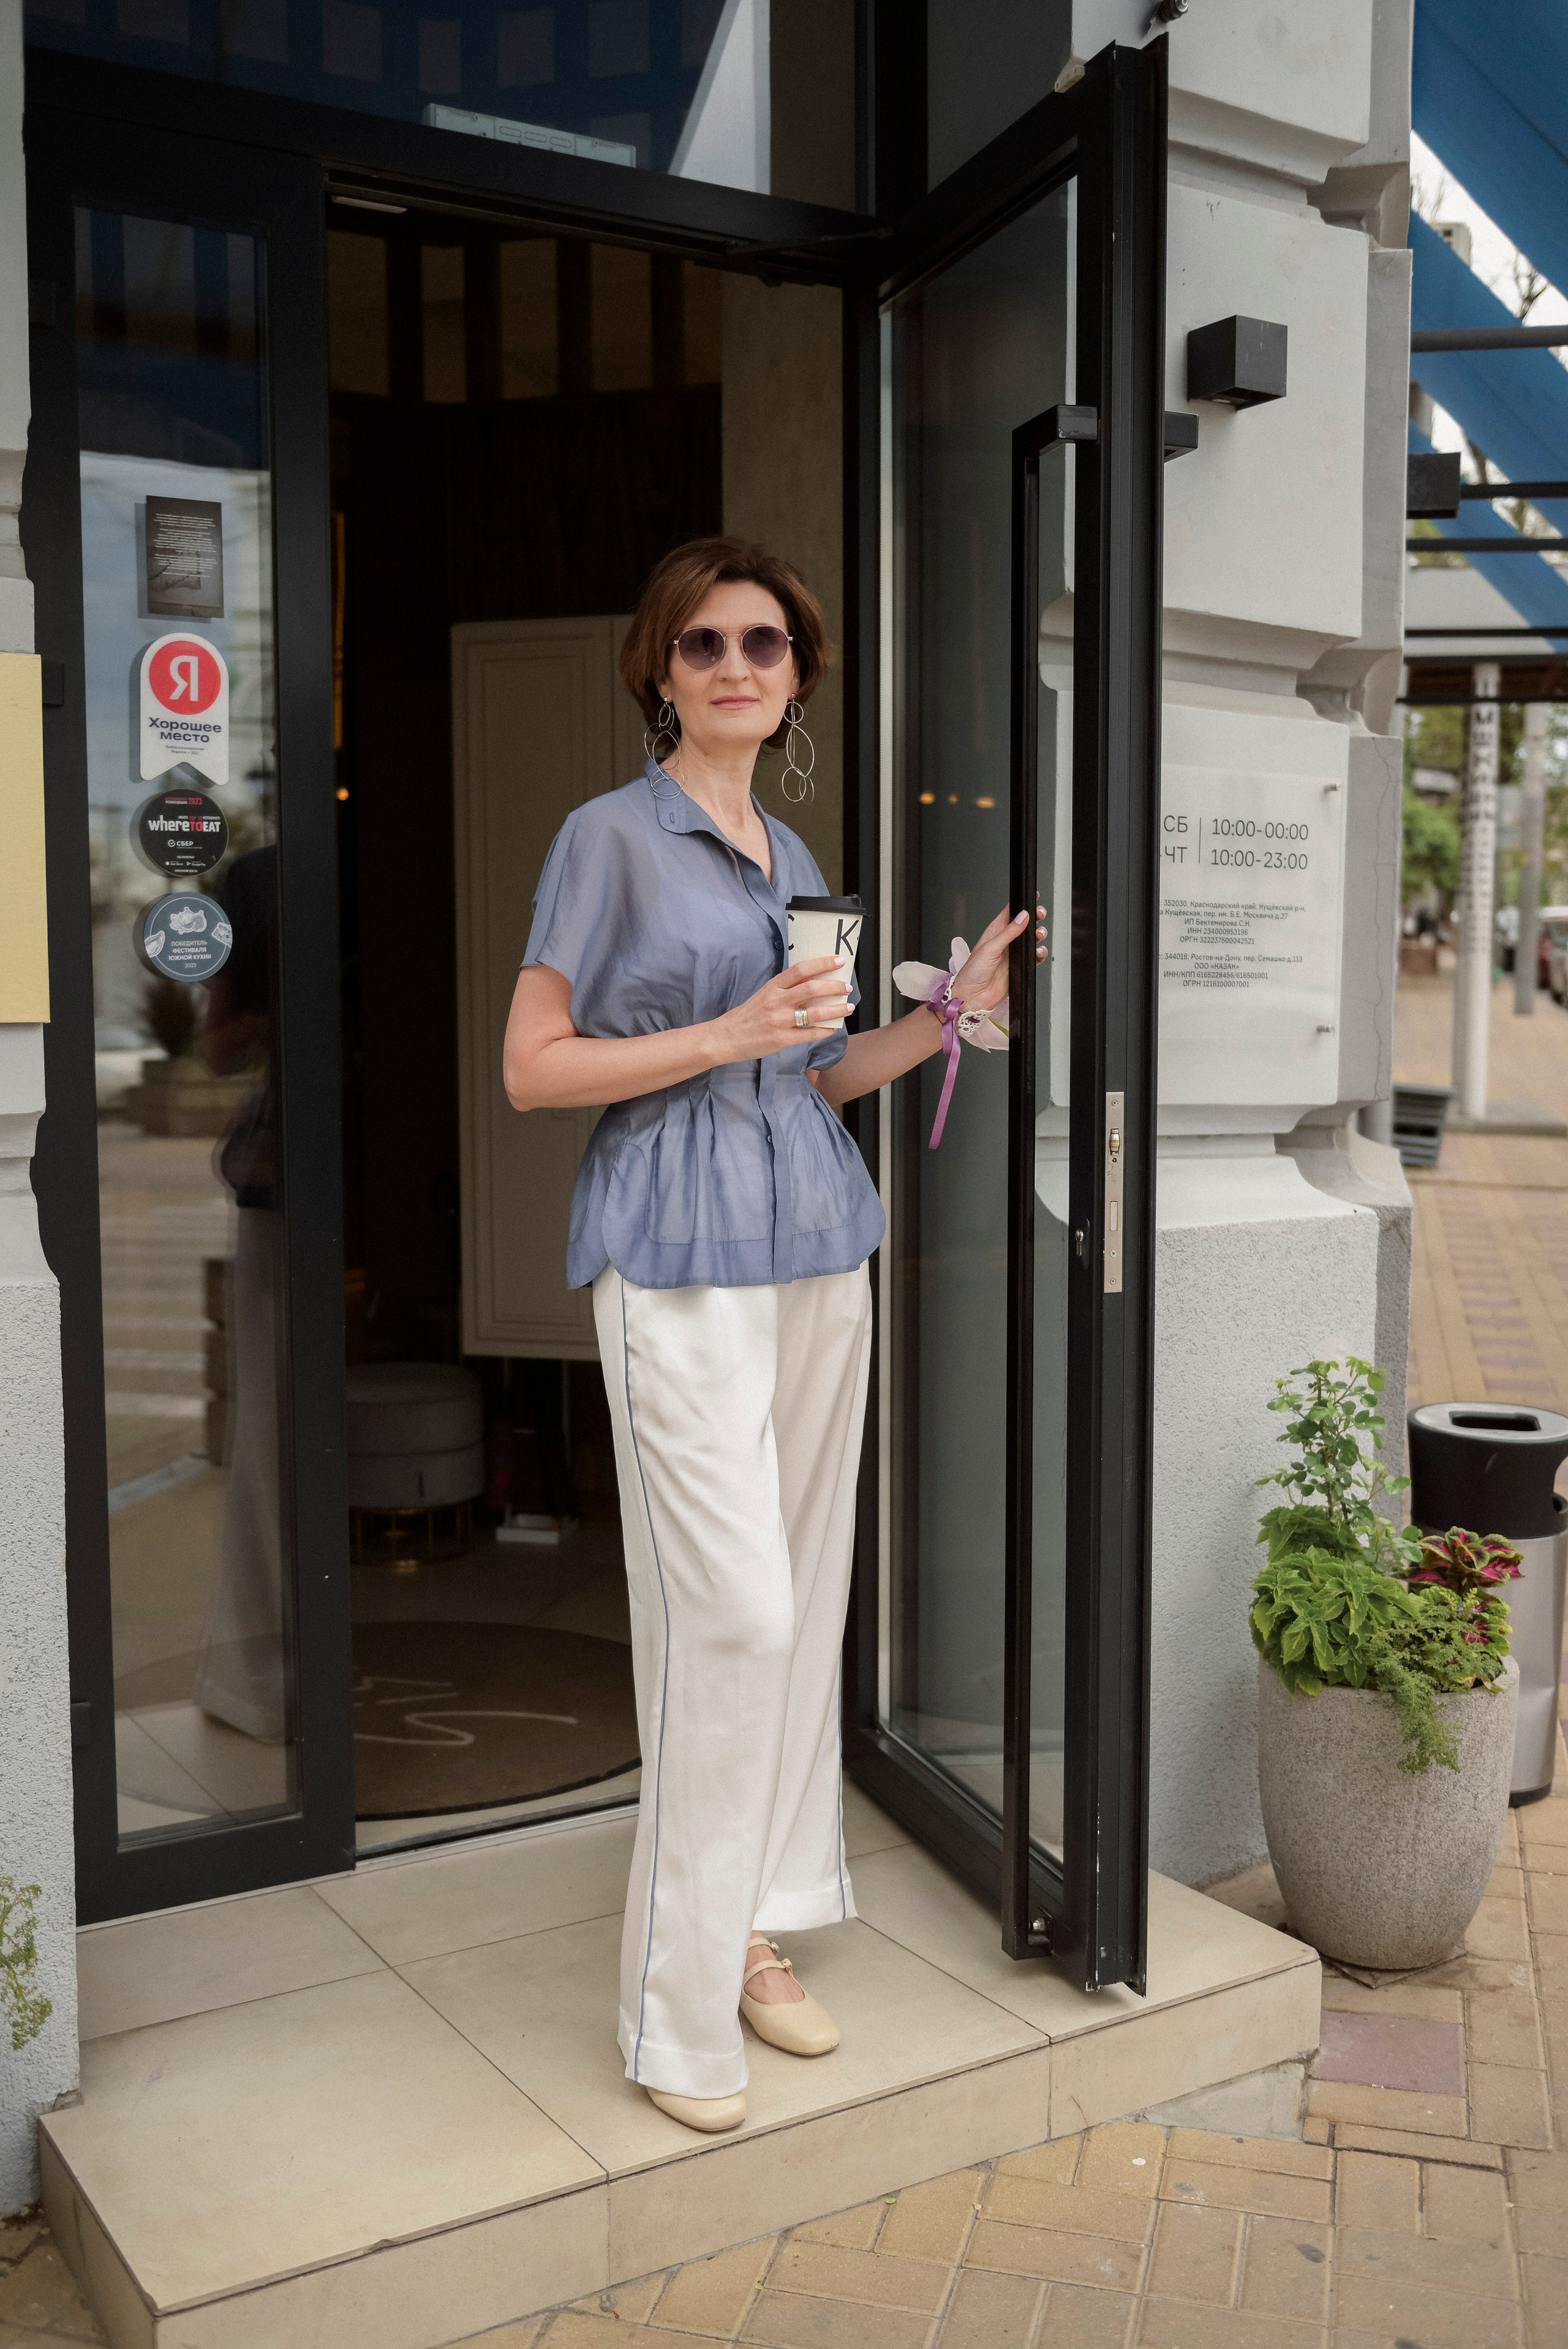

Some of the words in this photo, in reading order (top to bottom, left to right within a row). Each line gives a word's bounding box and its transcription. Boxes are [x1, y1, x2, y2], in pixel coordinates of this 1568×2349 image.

[169, 655, 198, 702] Я
[149, 717, 222, 733] Хорошее
[160, 732, 209, 742] место
[1164, 815, 1188, 832] СБ
[1212, 818, 1308, 840] 10:00-00:00
[1165, 846, 1187, 863] ЧТ
[1211, 849, 1308, 869] 10:00-23:00
[1190, 900, 1240, 909] Краснодарский
